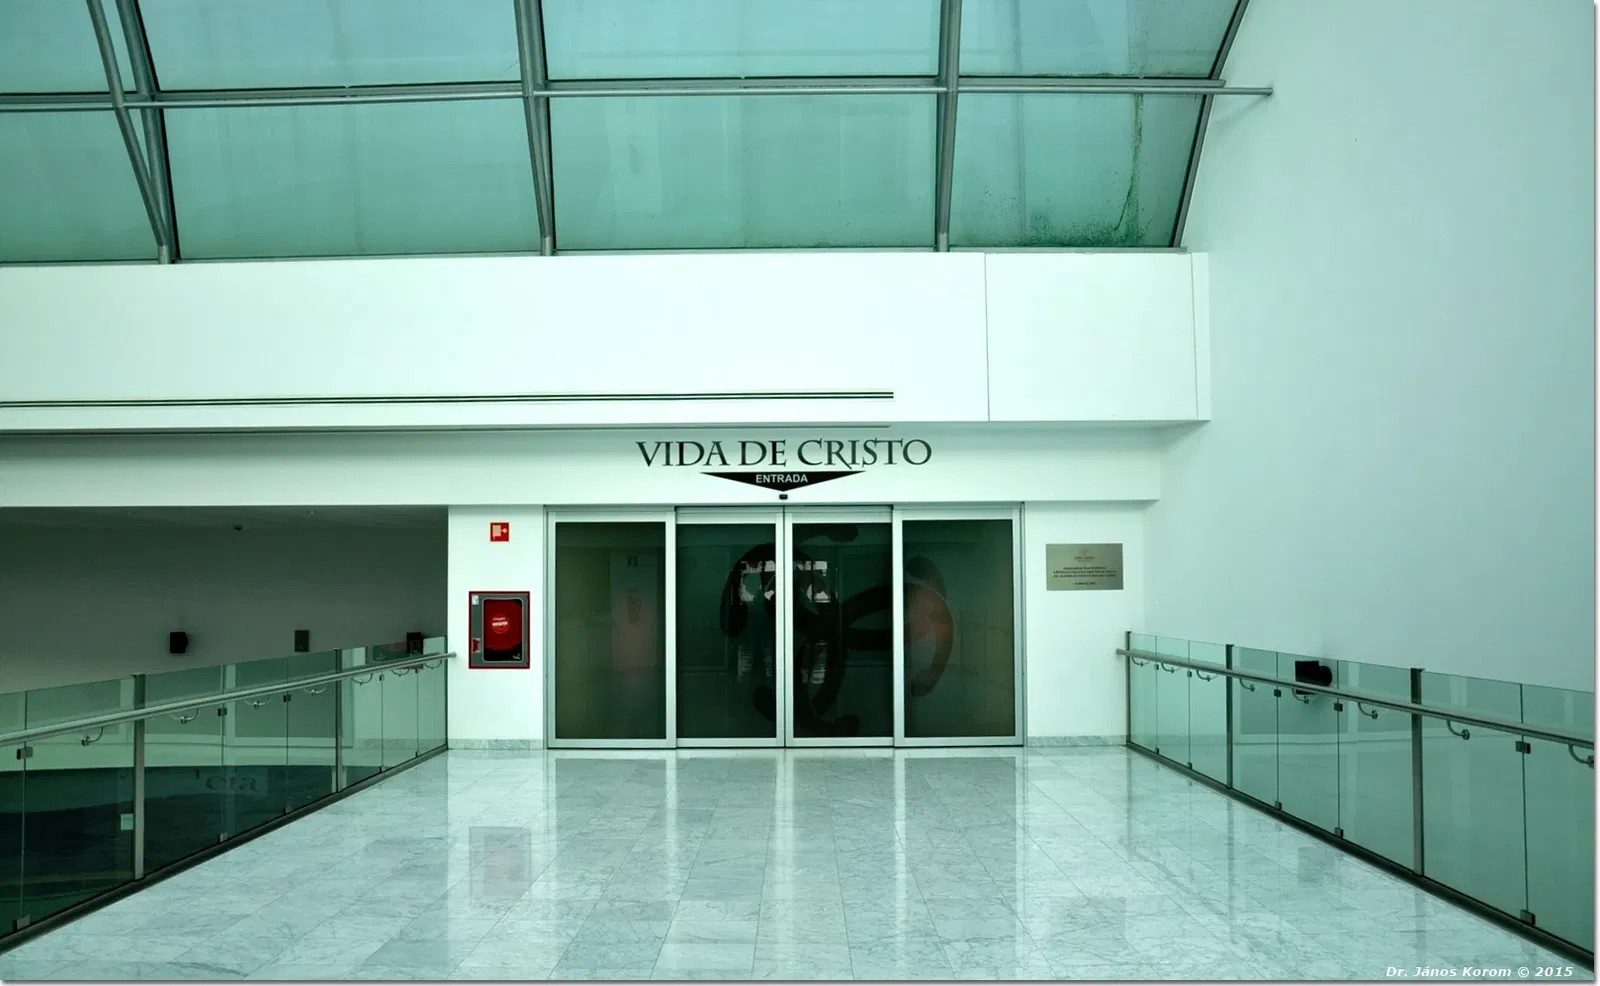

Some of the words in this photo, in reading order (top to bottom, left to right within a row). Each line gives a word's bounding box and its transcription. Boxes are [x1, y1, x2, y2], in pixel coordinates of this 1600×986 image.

[636, 440, 731, 468] VIDA
[737, 440, 787, 467] DE
[797, 438, 933, 470] CRISTO
[755, 473, 809, 484] ENTRADA
